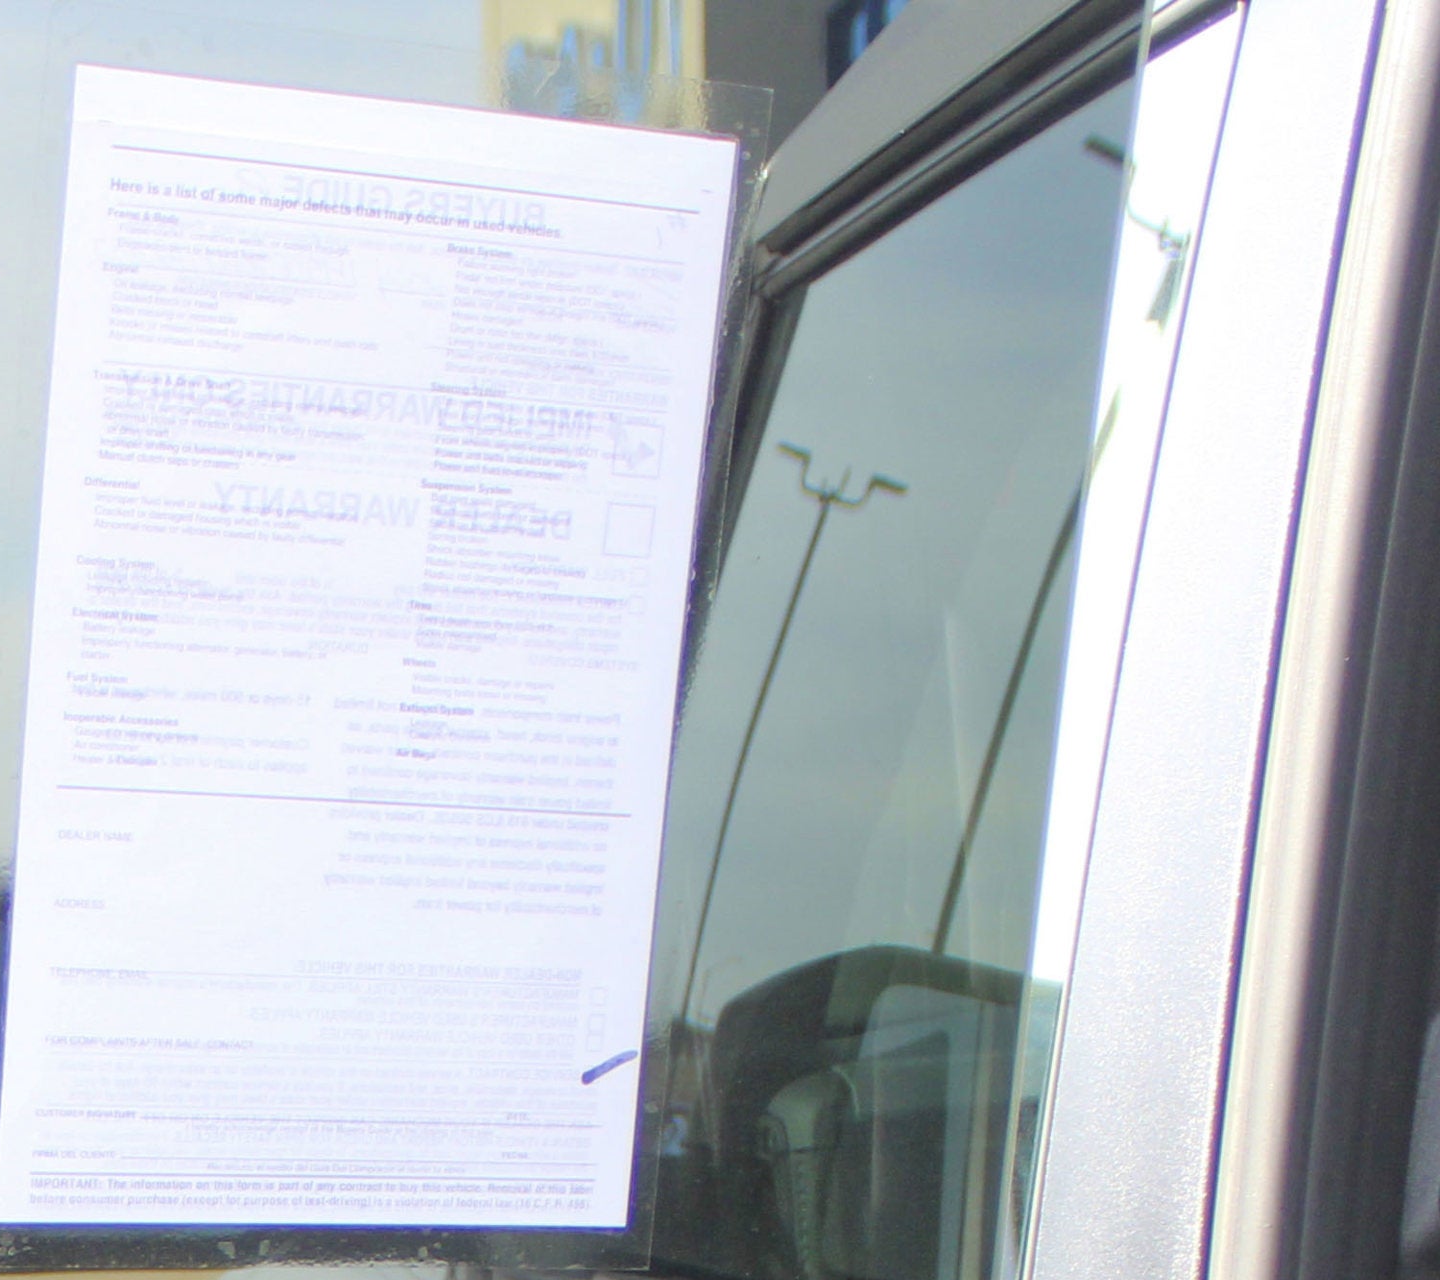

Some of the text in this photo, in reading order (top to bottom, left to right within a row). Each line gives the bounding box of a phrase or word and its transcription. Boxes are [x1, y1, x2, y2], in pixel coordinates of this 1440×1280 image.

[109, 178, 143, 194] Here
[146, 182, 159, 196] is
[163, 184, 172, 197] a
[175, 185, 197, 200] list
[200, 188, 214, 202] of
[218, 191, 255, 206] some
[259, 194, 299, 212] major
[303, 198, 351, 216] defects
[355, 204, 382, 219] that
[384, 208, 412, 224] may
[415, 212, 455, 227] occur
[456, 215, 470, 228] in
[473, 217, 504, 232] used
[107, 208, 141, 221] Frame
[476, 246, 513, 259] System
[102, 261, 139, 276] Engine
[83, 476, 140, 489] Differential
[420, 479, 512, 495] Suspension System
[118, 557, 155, 570] System
[66, 671, 128, 684] Fuel System
[62, 711, 178, 727] Inoperable Accessories
[57, 829, 132, 841] DEALER NAME
[53, 898, 105, 909] ADDRESS
[30, 1178, 102, 1189] IMPORTANT:
[107, 1179, 126, 1189] The
[130, 1179, 192, 1190] information
[195, 1180, 209, 1190] on
[213, 1180, 235, 1190] this
[237, 1180, 261, 1191] form
[264, 1181, 274, 1191] is
[277, 1182, 300, 1193] part
[302, 1181, 314, 1191] of
[316, 1183, 334, 1193] any
[338, 1181, 382, 1192] contract
[385, 1182, 397, 1192] to
[399, 1182, 418, 1194] buy
[422, 1182, 442, 1192] this
[487, 1183, 531, 1193] Removal
[29, 1193, 65, 1204] before
[68, 1196, 123, 1205] consumer
[127, 1195, 179, 1207] purchase
[225, 1195, 240, 1205] for
[243, 1197, 290, 1208] purpose
[293, 1196, 303, 1206] of
[373, 1196, 383, 1207] is
[385, 1198, 391, 1207] a
[394, 1197, 440, 1207] violation
[442, 1197, 454, 1207] of
[455, 1197, 494, 1207] federal
